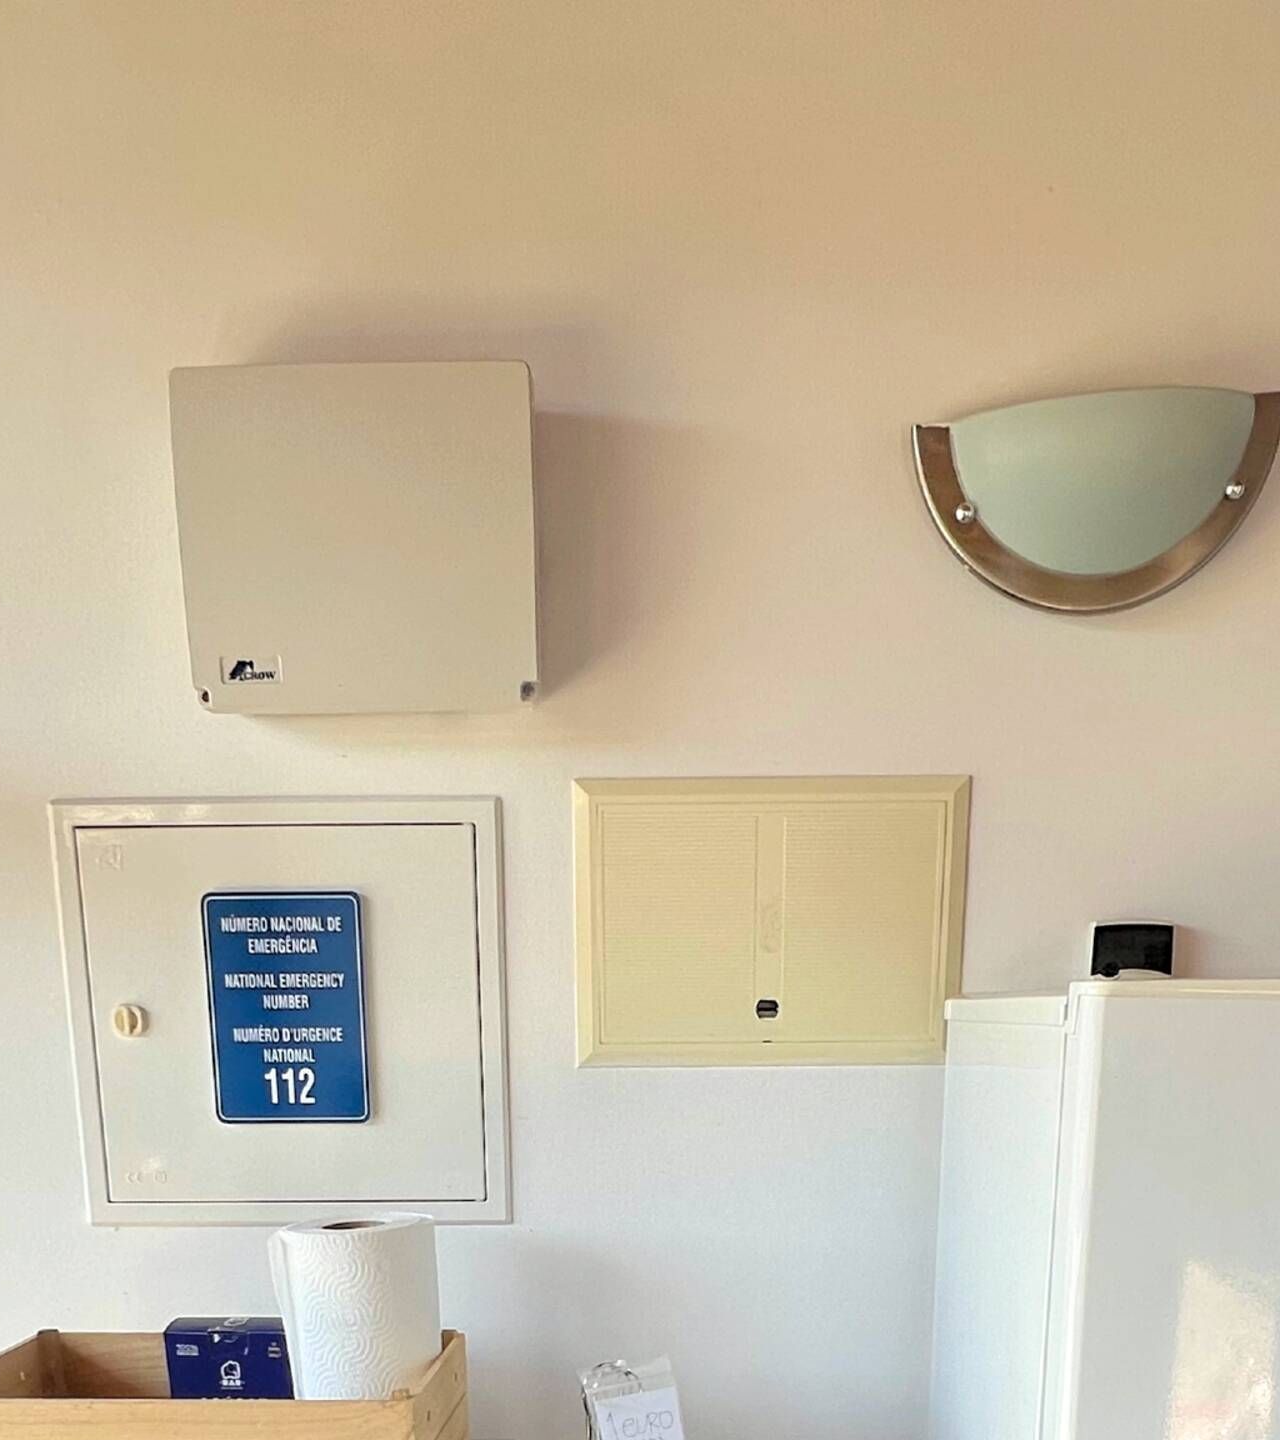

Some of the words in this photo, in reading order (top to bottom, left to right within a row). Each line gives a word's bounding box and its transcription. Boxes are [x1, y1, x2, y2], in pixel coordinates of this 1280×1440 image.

[221, 914, 267, 933] NÚMERO
[270, 916, 324, 932] NACIONAL
[327, 916, 342, 932] DE
[248, 935, 318, 954] EMERGÊNCIA
[224, 974, 277, 988] NATIONAL
[279, 973, 345, 988] EMERGENCY
[263, 995, 309, 1010] NUMBER
[233, 1025, 279, 1043] NUMÉRO
[282, 1028, 343, 1042] D'URGENCE
[264, 1048, 315, 1063] NATIONAL
[264, 1067, 316, 1105] 112
